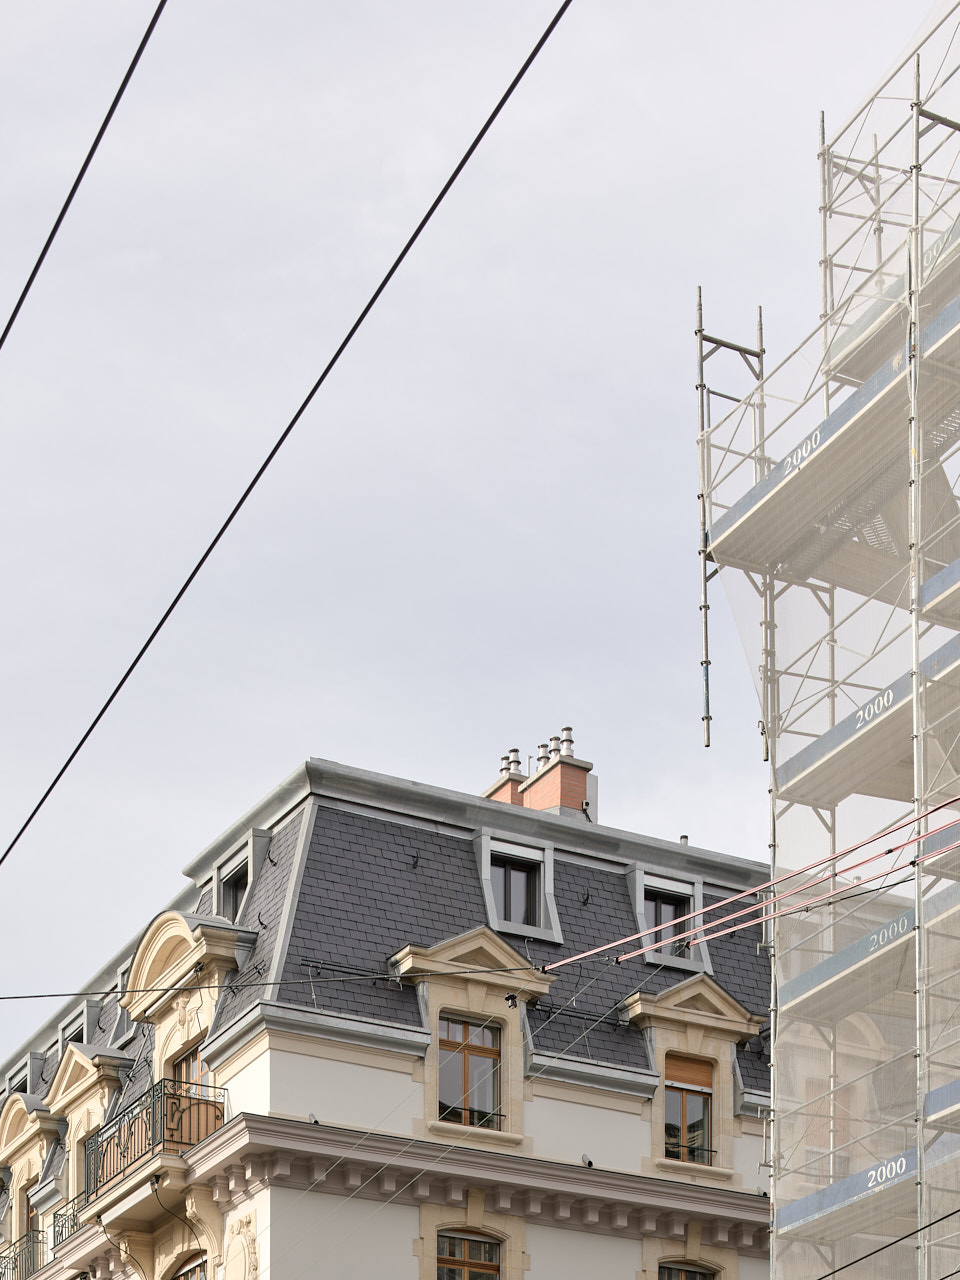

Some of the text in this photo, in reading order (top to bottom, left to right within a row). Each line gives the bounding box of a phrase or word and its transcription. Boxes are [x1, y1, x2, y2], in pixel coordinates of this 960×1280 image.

[784, 431, 820, 475] 2000
[856, 690, 893, 729] 2000
[870, 917, 907, 951] 2000
[868, 1157, 906, 1187] 2000
